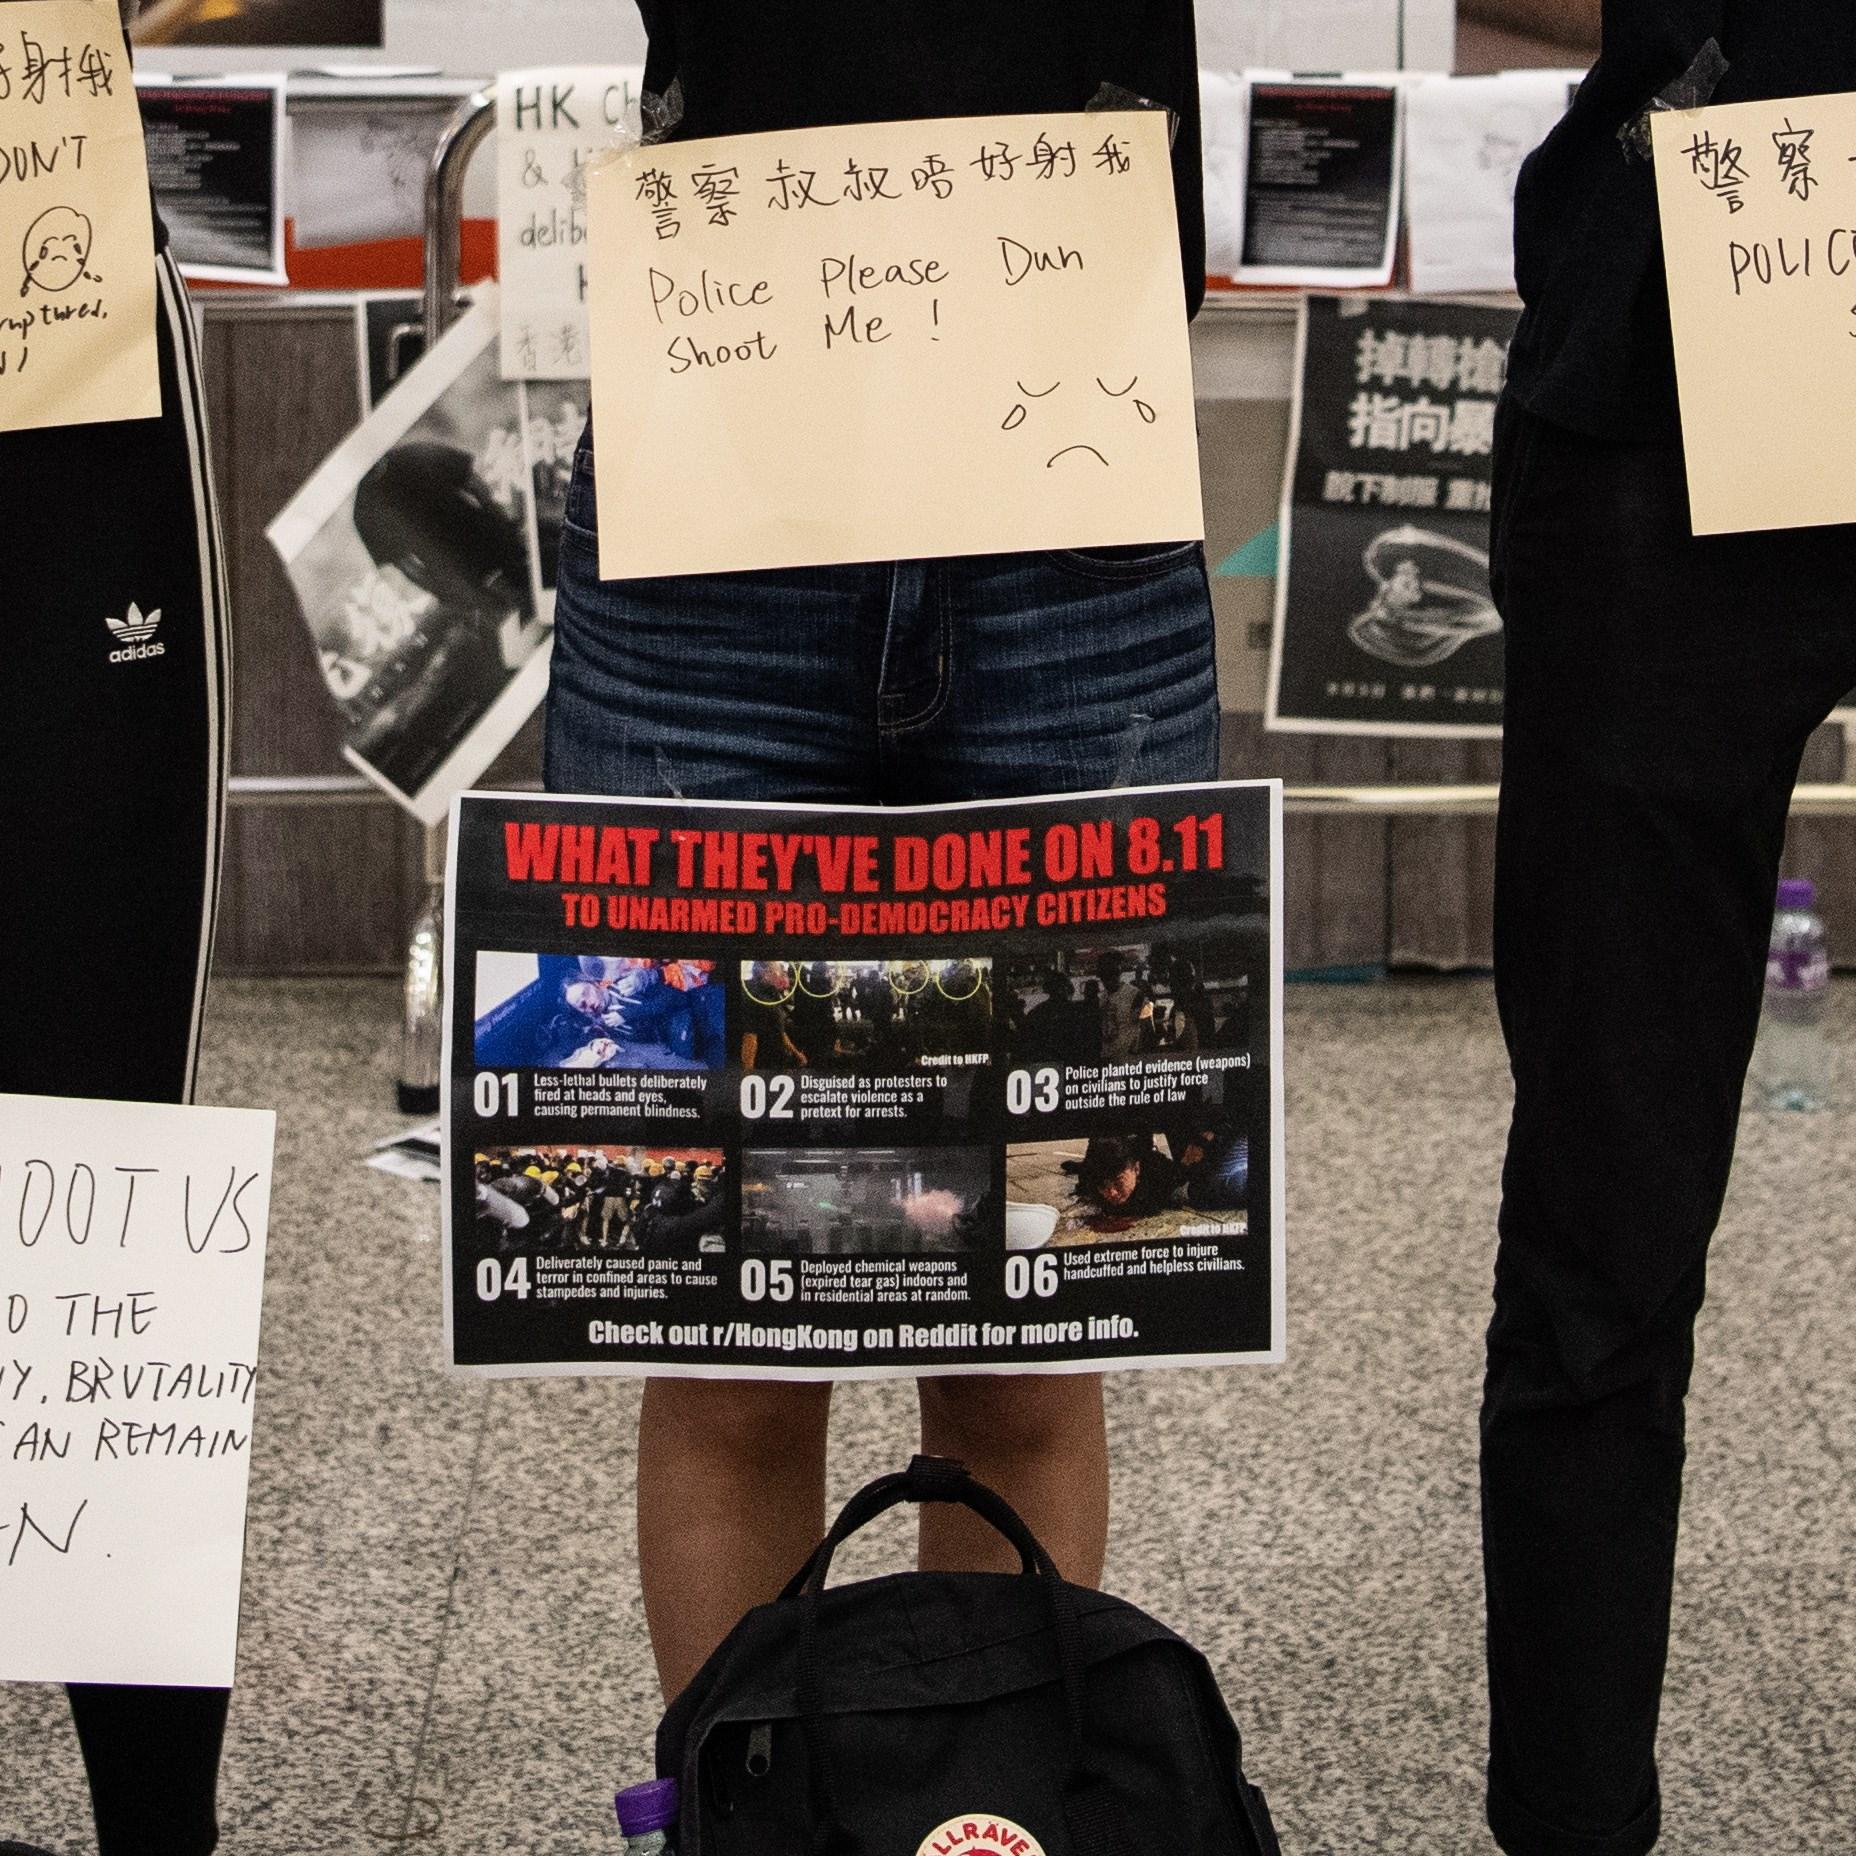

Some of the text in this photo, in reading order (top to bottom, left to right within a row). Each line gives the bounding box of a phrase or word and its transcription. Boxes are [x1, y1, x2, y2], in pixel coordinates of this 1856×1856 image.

[516, 86, 579, 130] HK
[635, 132, 1132, 241] 警察叔叔唔好射我
[647, 267, 775, 324] Police
[820, 256, 950, 295] Please
[996, 235, 1084, 287] Dun
[667, 334, 779, 375] Shoot
[824, 306, 893, 349] Me
[109, 642, 165, 663] adidas
[505, 813, 1223, 892] WHAT THEY'VE DONE ON 8.11
[562, 883, 1166, 934] TO UNARMED PRO-DEMOCRACY CITIZENS
[921, 1054, 989, 1065] Credit to HKFP
[474, 1071, 518, 1117] 01
[534, 1074, 707, 1090] Less-lethal bullets deliberately
[534, 1090, 666, 1106] fired at heads and eyes,
[740, 1075, 794, 1118] 02
[801, 1076, 947, 1091] Disguised as protesters to
[801, 1091, 923, 1103] escalate violence as a
[1007, 1068, 1059, 1115] 03
[534, 1104, 700, 1118] causing permanent blindness.
[801, 1106, 907, 1120] pretext for arrests.
[182, 1165, 261, 1256] US
[476, 1257, 531, 1301] 04
[741, 1259, 794, 1301] 05
[1006, 1253, 1058, 1299] 06
[56, 1290, 160, 1338] THE
[589, 1315, 1139, 1351] Check out r/HongKong on Reddit for more info.
[65, 1356, 258, 1405] BRUTALITY
[93, 1419, 248, 1463] REMAIN
[923, 1820, 1037, 1856] LLRÄVE
